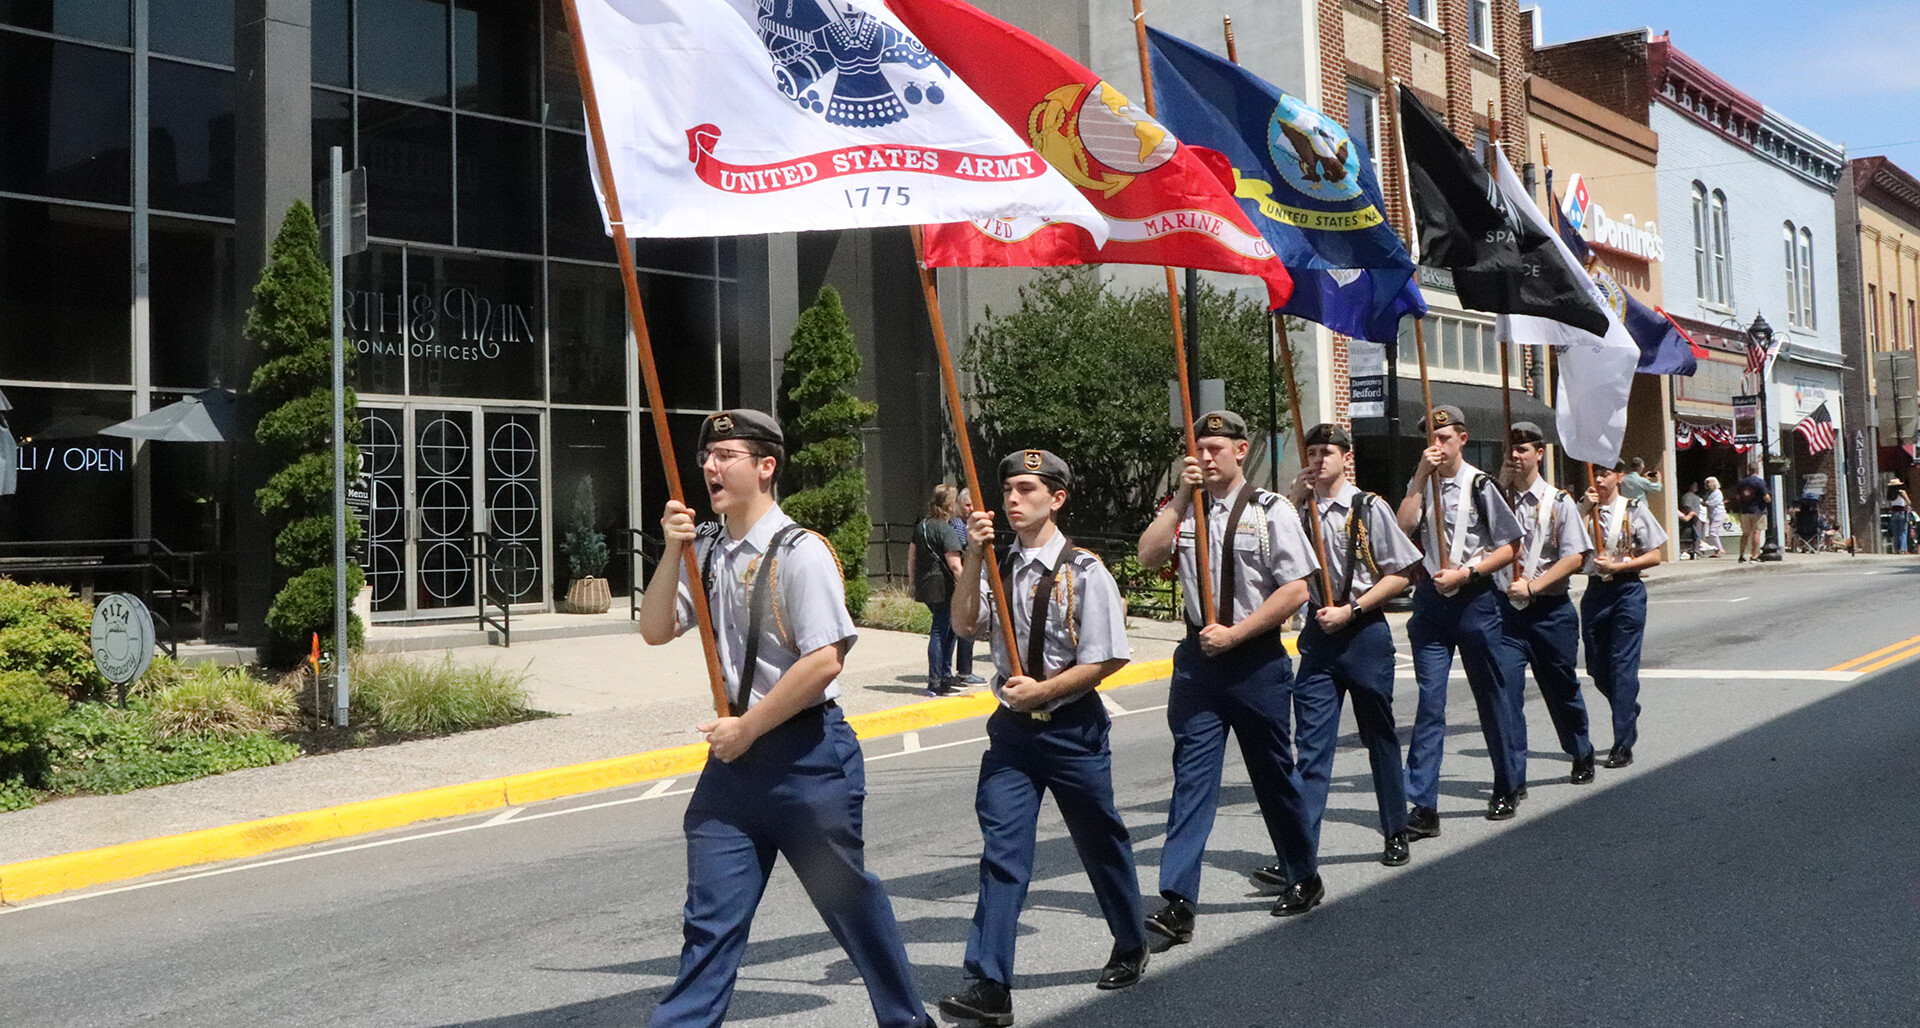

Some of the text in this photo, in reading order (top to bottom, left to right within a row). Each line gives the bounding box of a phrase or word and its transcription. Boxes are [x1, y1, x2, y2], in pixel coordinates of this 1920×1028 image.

[719, 149, 1036, 193] UNITED STATES ARMY
[844, 186, 911, 209] 1775
[1143, 212, 1224, 238] MARINE
[1266, 203, 1378, 227] UNITED STATES NA
[1485, 230, 1517, 243] SPA
[1592, 203, 1665, 262] Domino's
[343, 289, 403, 335] RTH
[410, 294, 437, 342] &
[410, 343, 479, 361] OFFICES
[1352, 379, 1382, 387] Downtown
[1352, 388, 1381, 398] Bedford
[16, 446, 37, 471] LI
[63, 447, 124, 472] OPEN
[348, 488, 369, 499] Menu
[101, 603, 130, 624] PITA
[96, 648, 138, 676] Company
